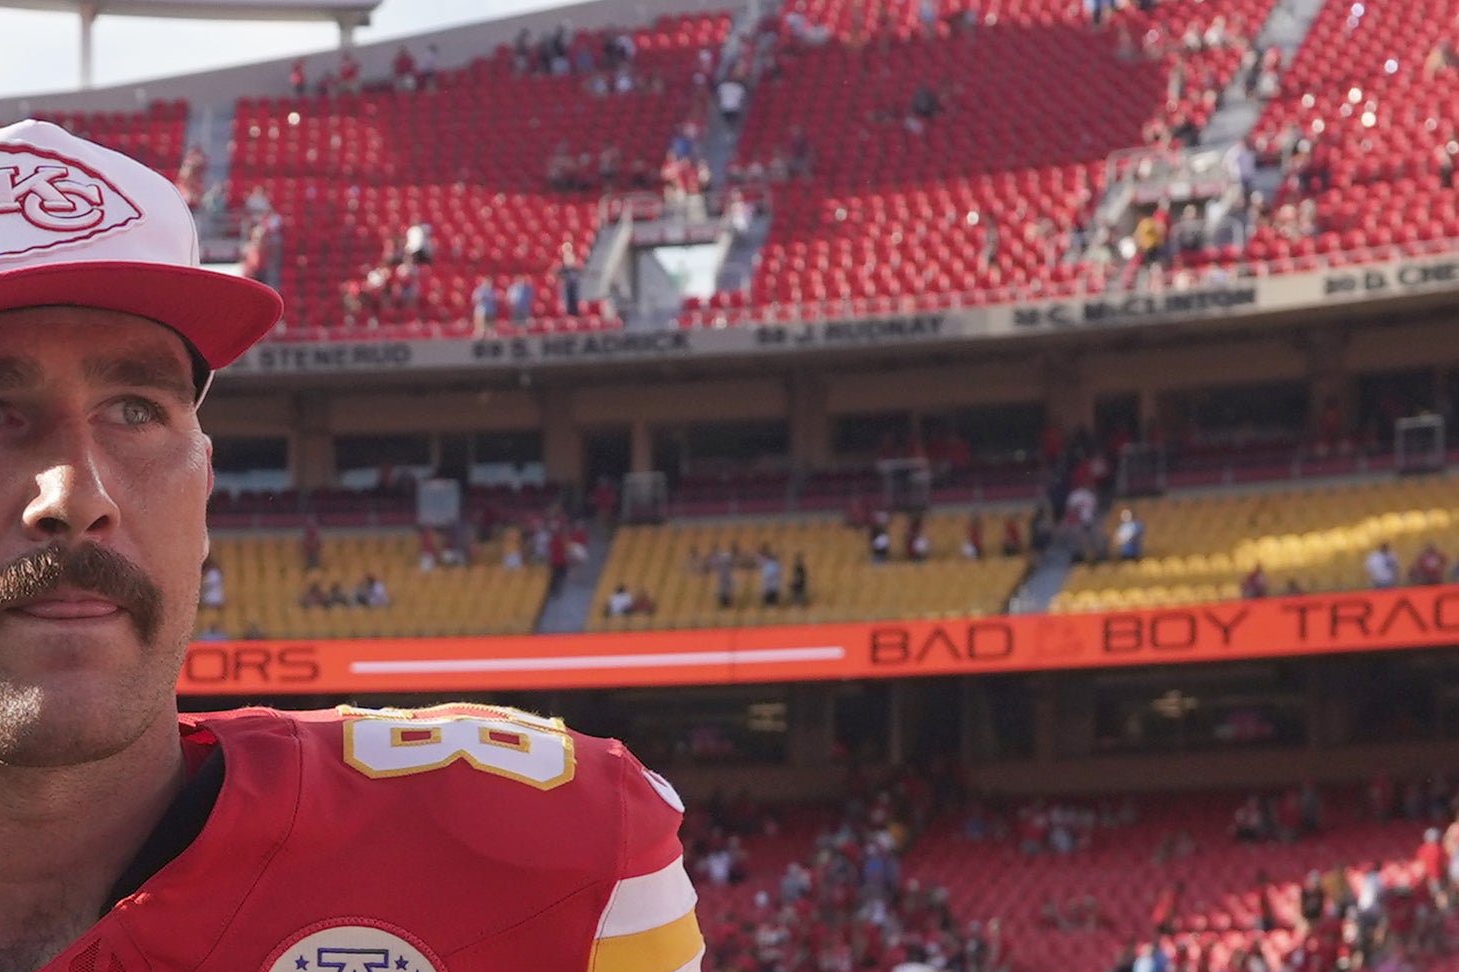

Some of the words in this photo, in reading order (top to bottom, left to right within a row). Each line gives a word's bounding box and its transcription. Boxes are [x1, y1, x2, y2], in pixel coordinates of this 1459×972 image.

[869, 623, 1014, 665] BAD
[1102, 608, 1251, 655] BOY
[1283, 593, 1459, 641] TRAC
[338, 703, 577, 791] 8
